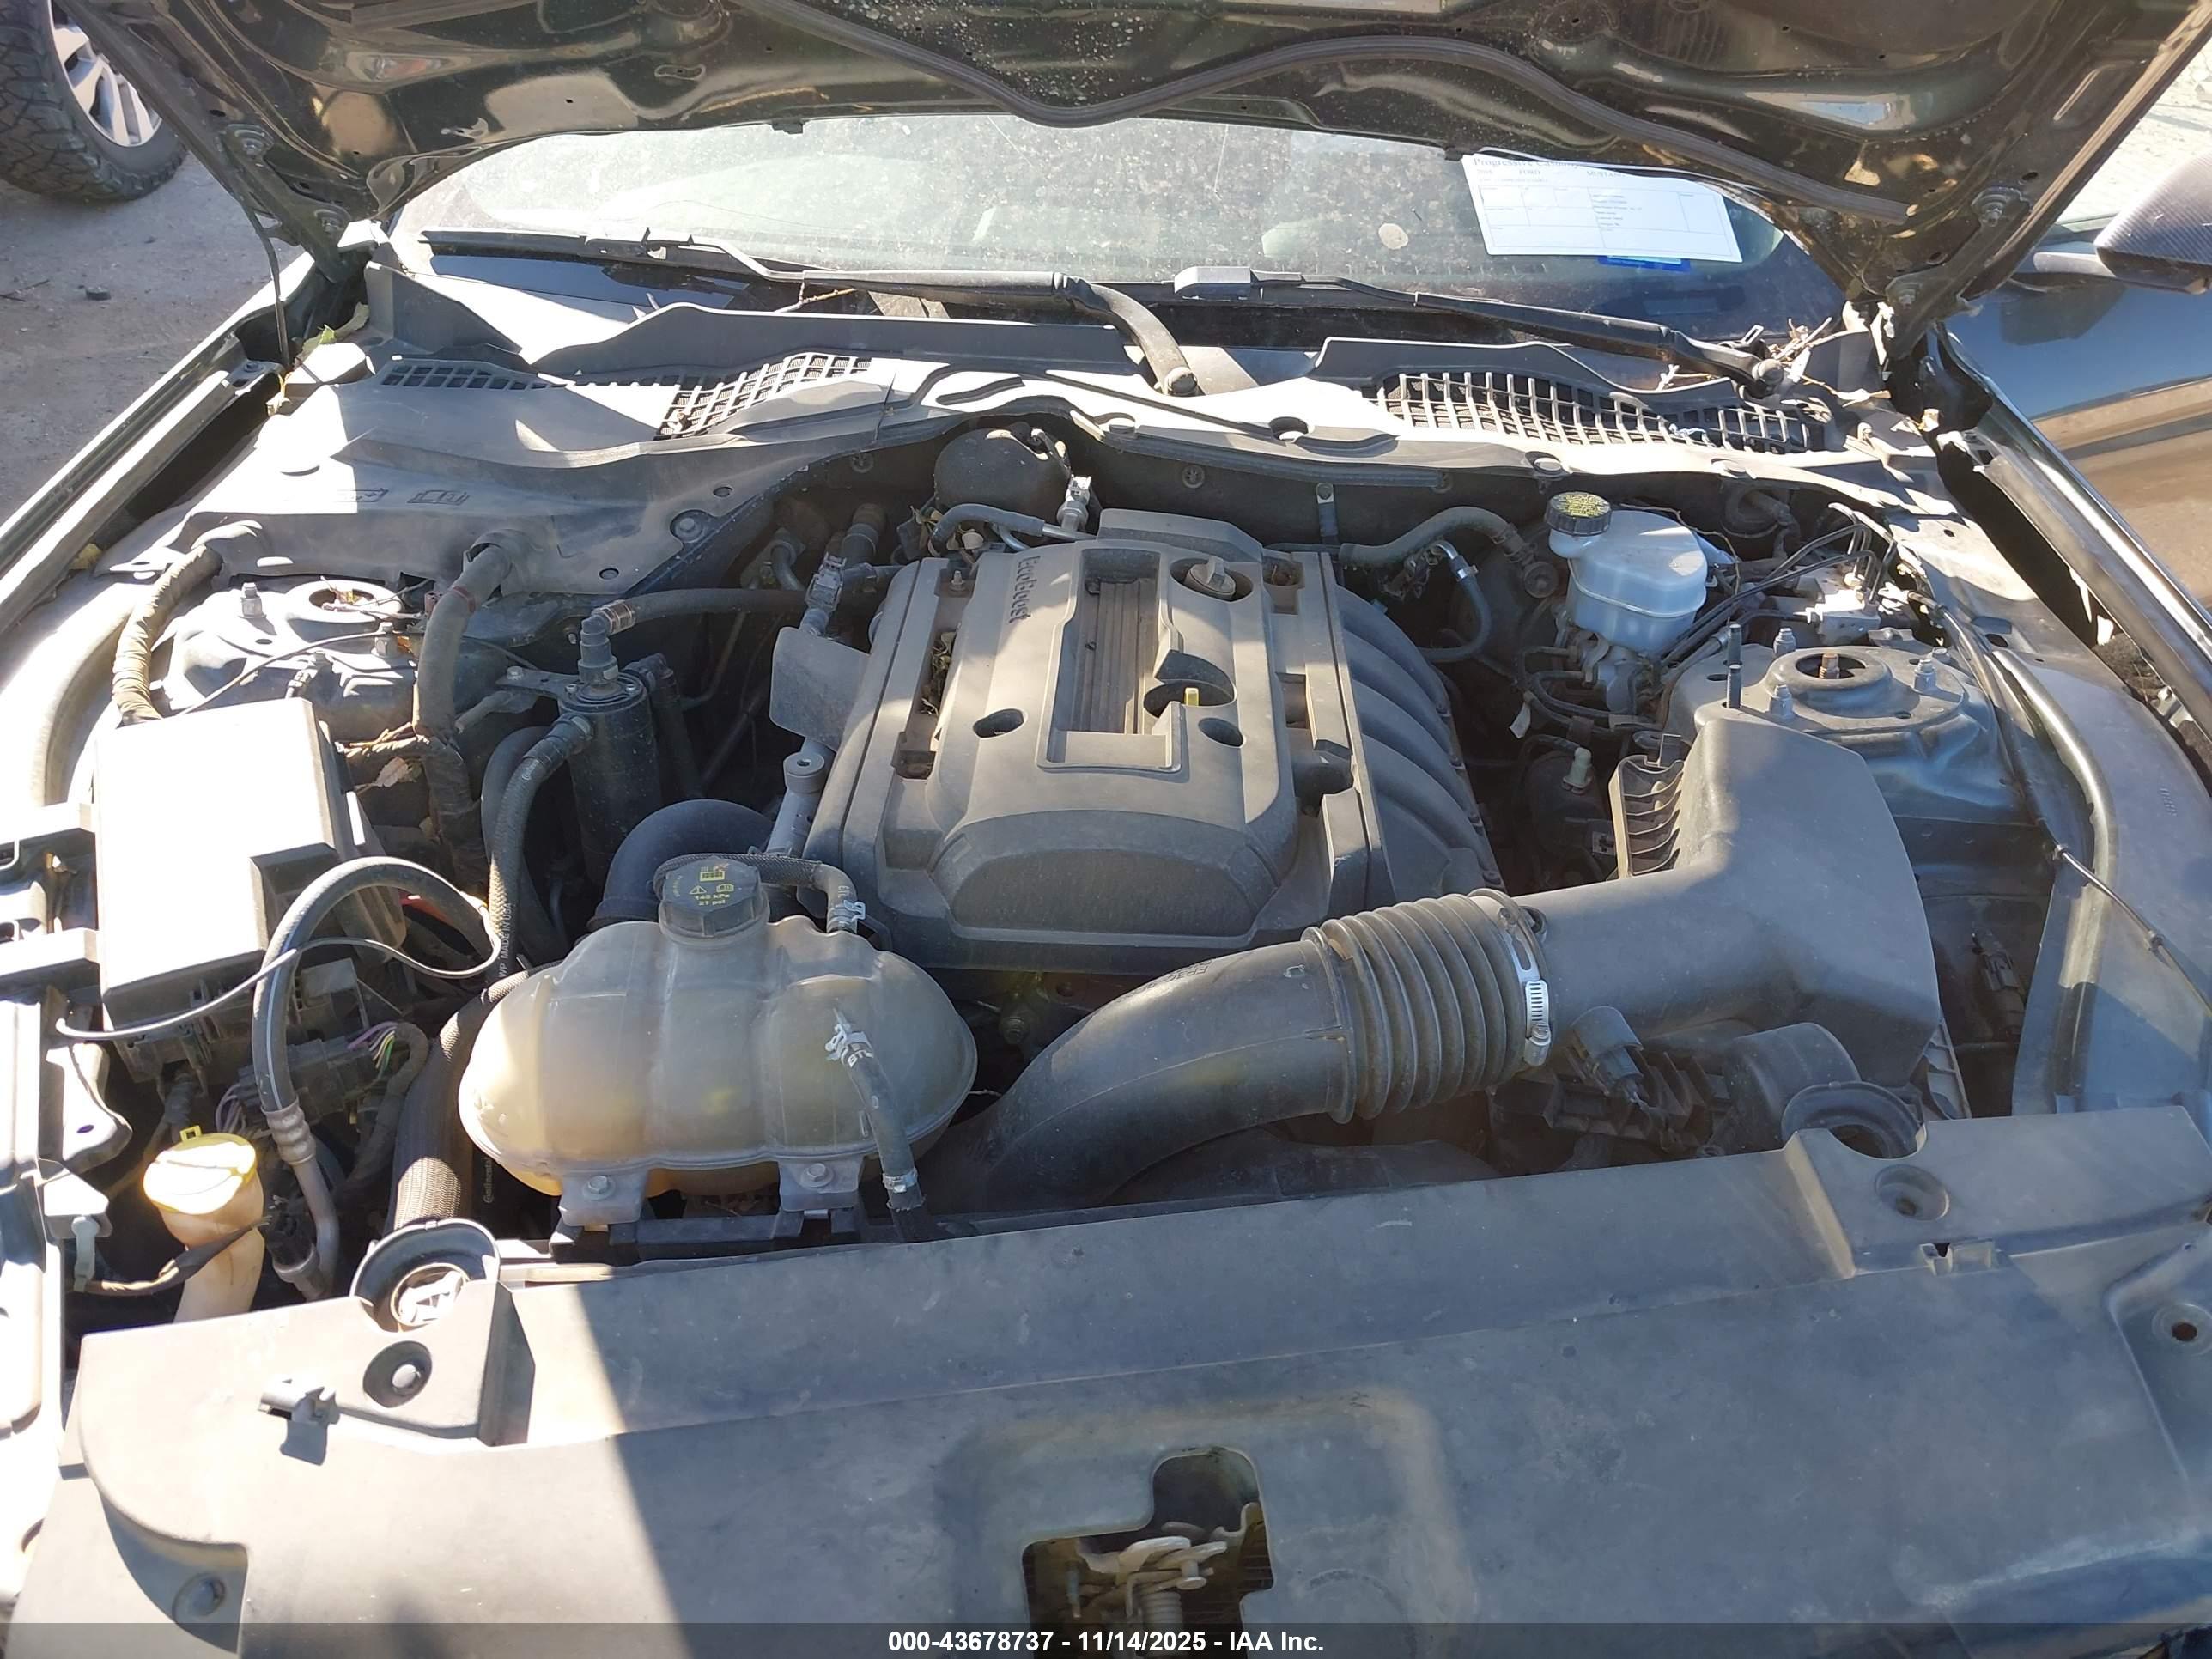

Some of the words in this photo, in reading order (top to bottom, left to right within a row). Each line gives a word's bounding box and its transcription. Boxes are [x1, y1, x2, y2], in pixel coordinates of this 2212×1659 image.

[1009, 556, 1041, 623] EcoBoost
[504, 902, 513, 921] USA
[501, 921, 511, 932] IN
[500, 931, 510, 959] MADE
